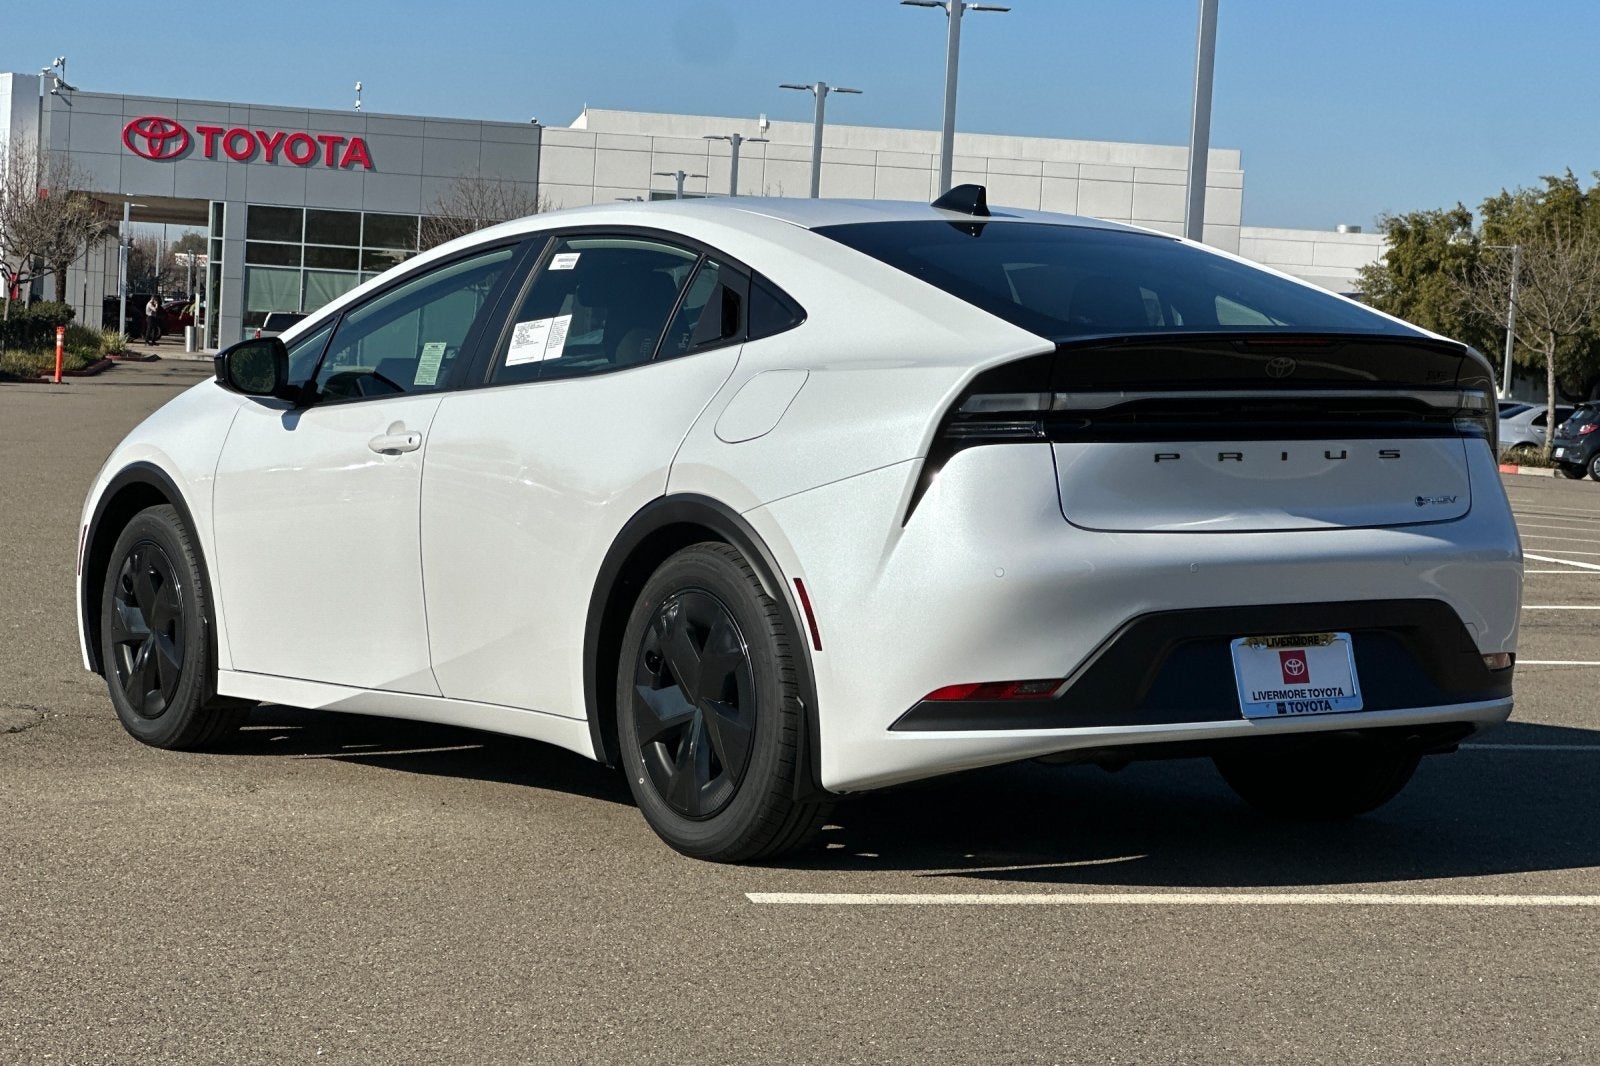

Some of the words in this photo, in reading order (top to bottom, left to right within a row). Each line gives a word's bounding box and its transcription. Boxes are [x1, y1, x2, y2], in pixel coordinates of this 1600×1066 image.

[196, 126, 372, 169] TOYOTA
[1154, 449, 1401, 463] PRIUS
[1266, 635, 1320, 647] LIVERMORE
[1252, 689, 1307, 701] LIVERMORE
[1308, 687, 1344, 698] TOYOTA
[1288, 699, 1333, 713] TOYOTA
